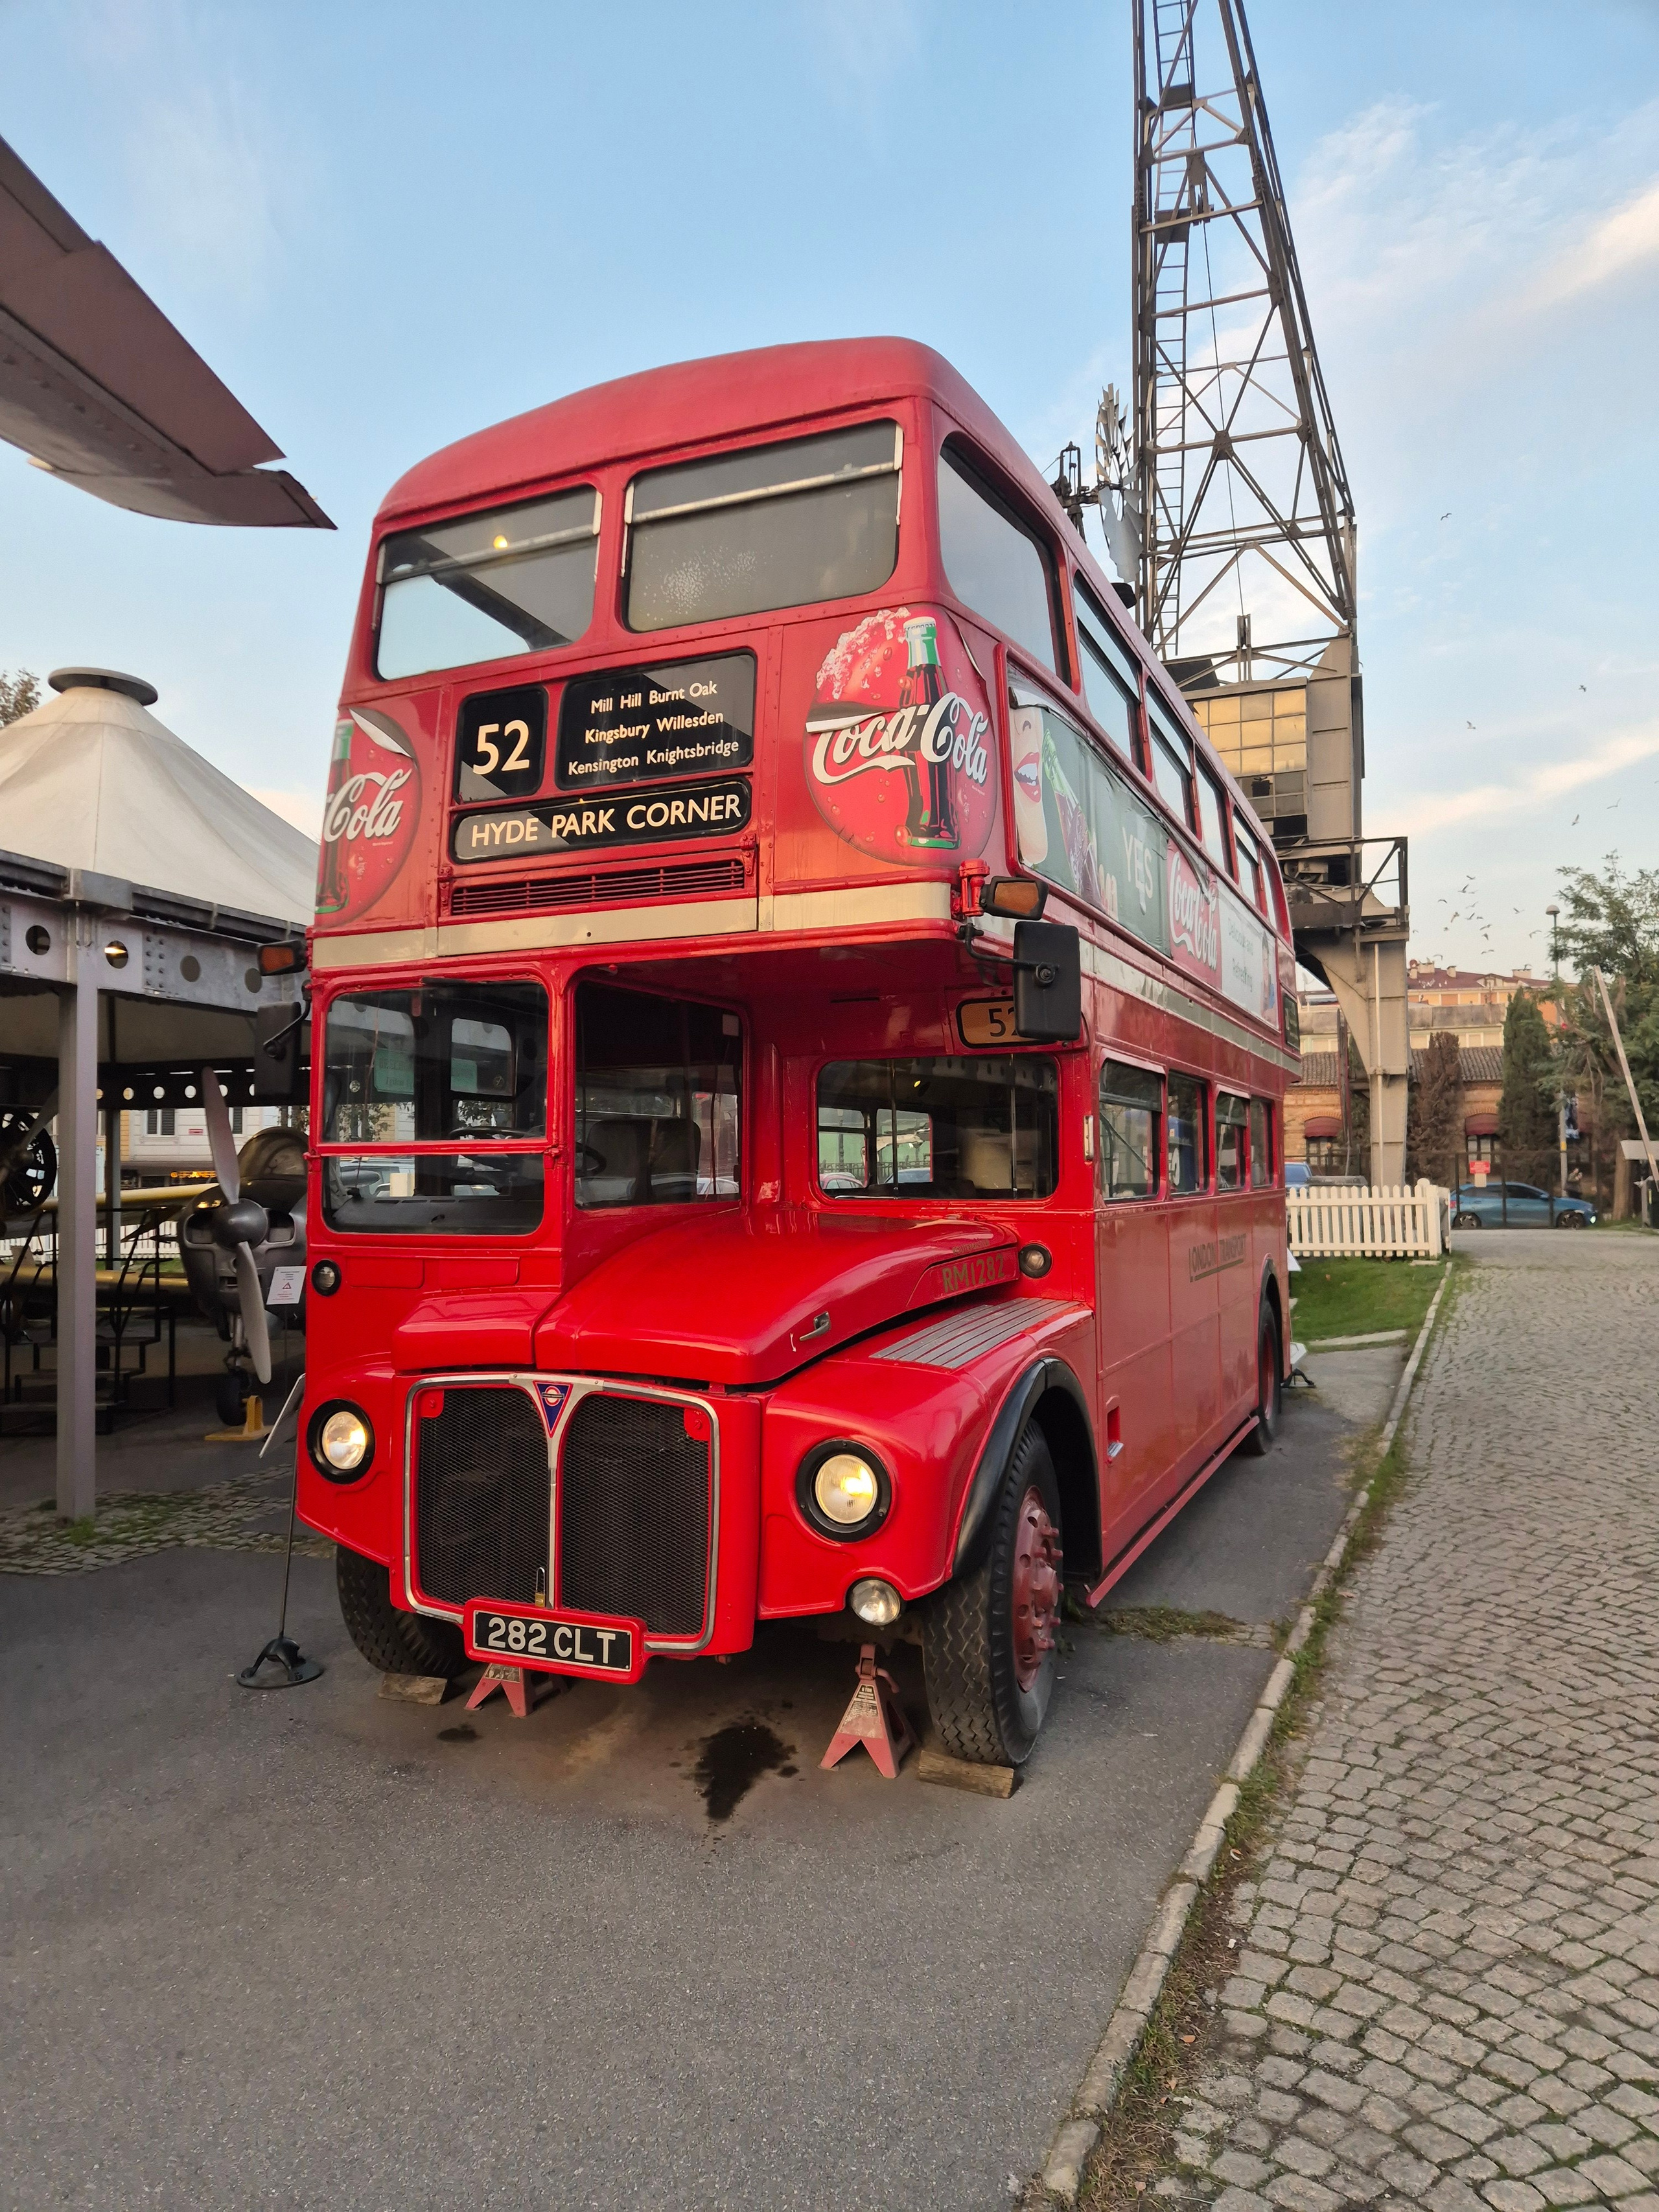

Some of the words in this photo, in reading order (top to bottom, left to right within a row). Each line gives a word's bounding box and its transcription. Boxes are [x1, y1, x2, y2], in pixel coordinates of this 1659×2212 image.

[591, 697, 612, 714] Mill
[620, 693, 642, 709] Hill
[649, 688, 685, 704] Burnt
[689, 681, 717, 697] Oak
[472, 719, 529, 775] 52
[585, 723, 650, 744] Kingsbury
[656, 712, 724, 732] Willesden
[568, 756, 639, 775] Kensington
[646, 739, 739, 765] Knightsbridge
[471, 817, 539, 848] HYDE
[551, 808, 616, 839] PARK
[626, 794, 742, 830] CORNER
[1122, 826, 1153, 899] YES
[988, 1007, 1019, 1038] 5
[942, 1253, 1005, 1294] RM1282
[488, 1617, 547, 1655] 282
[553, 1626, 616, 1664] CLT
